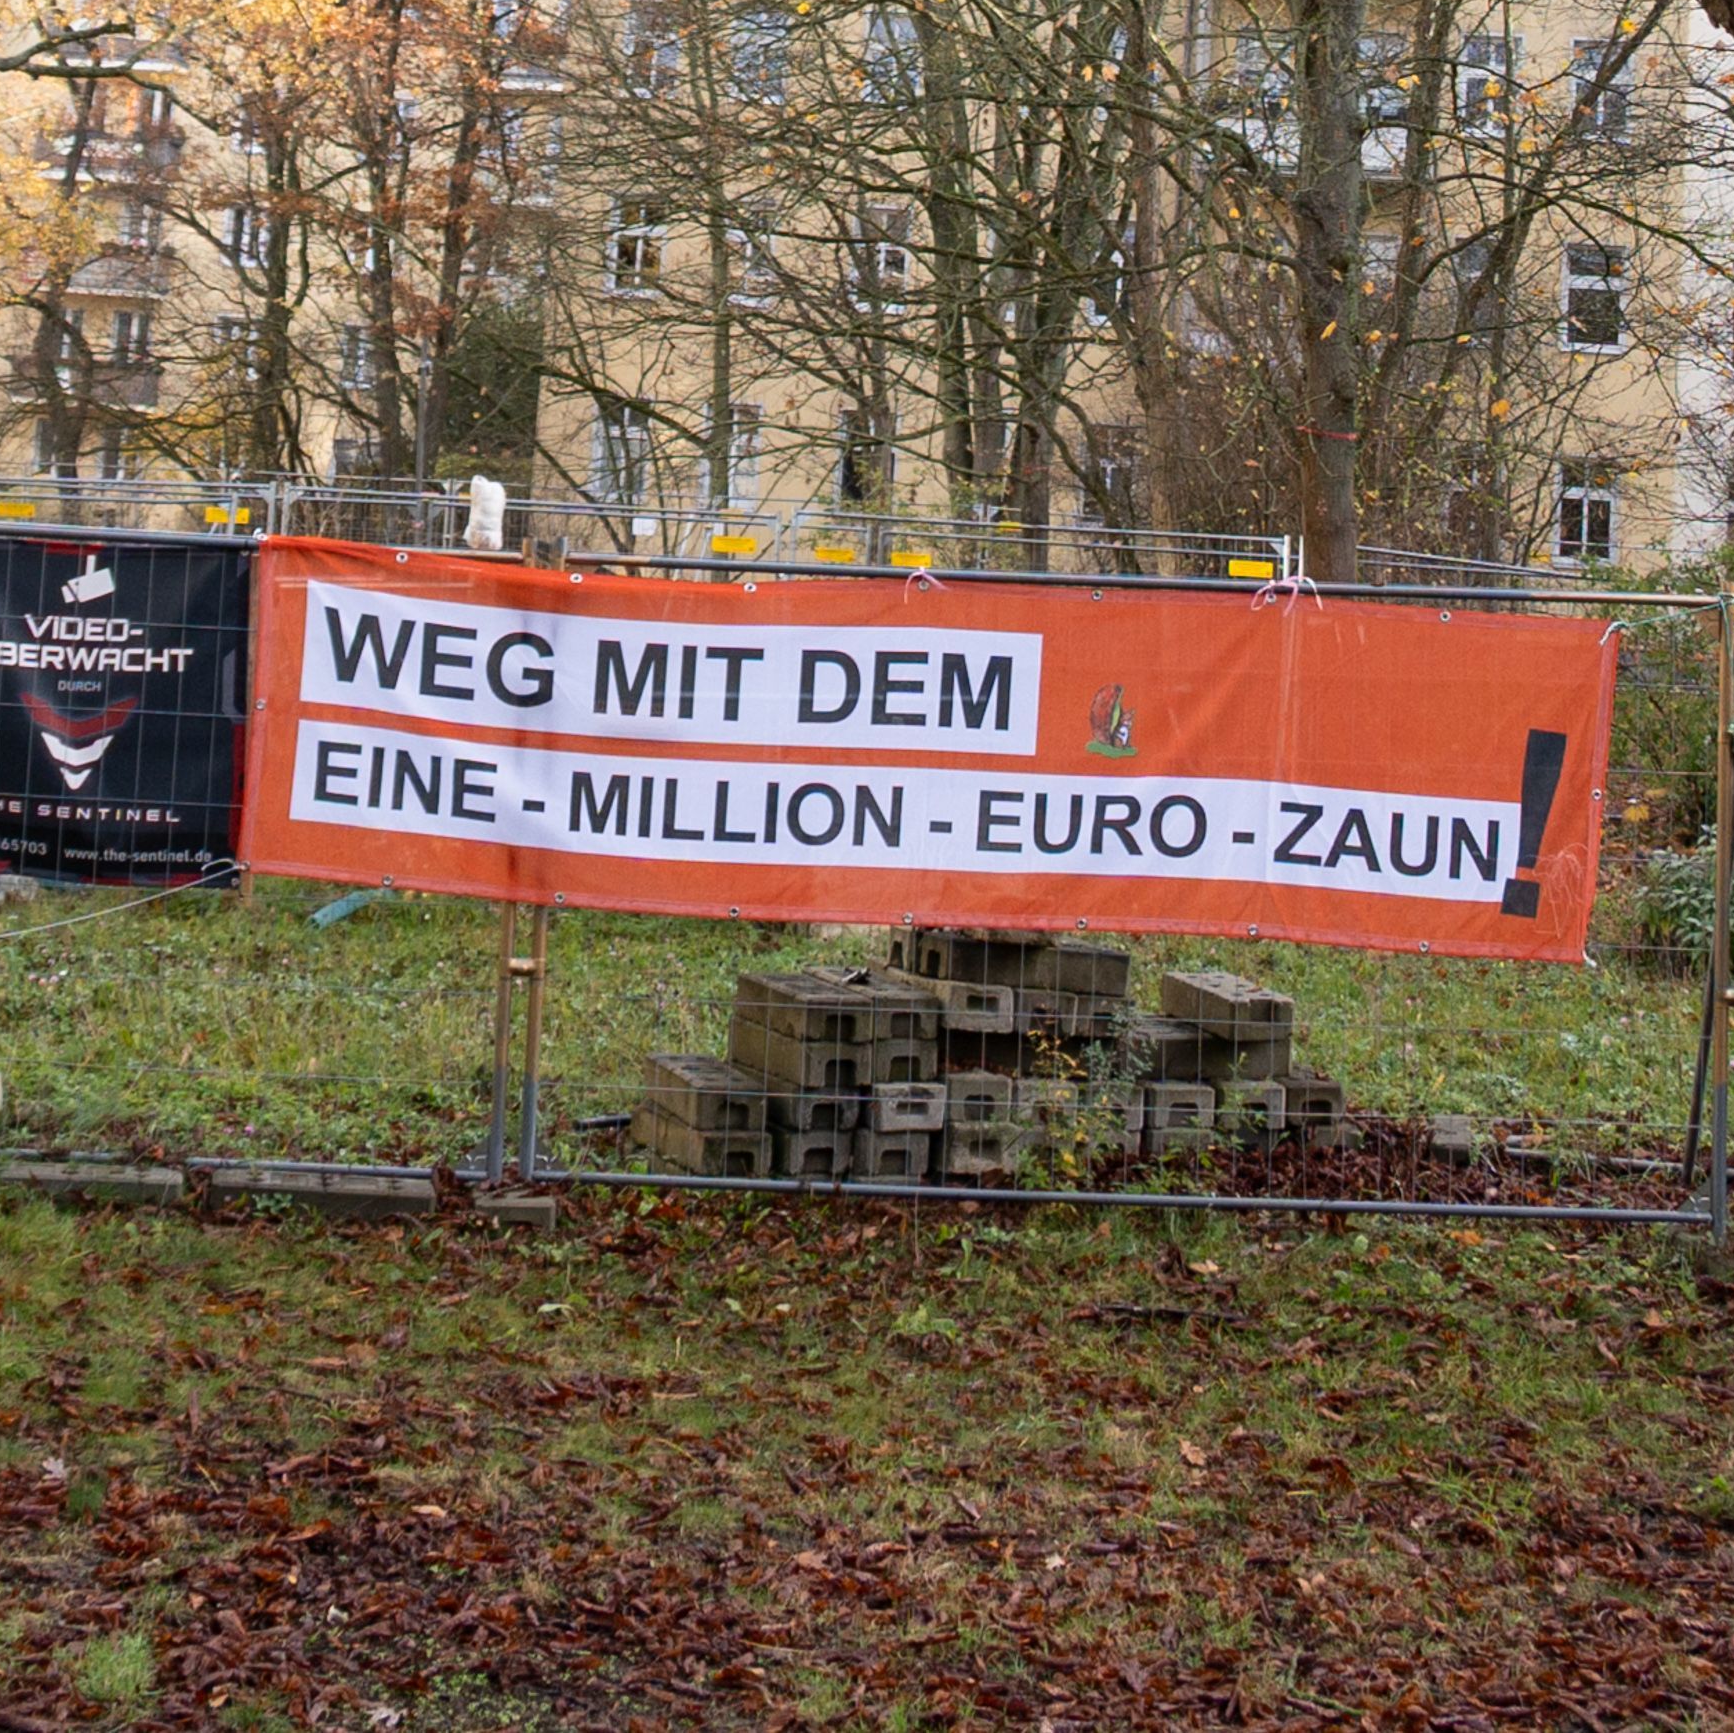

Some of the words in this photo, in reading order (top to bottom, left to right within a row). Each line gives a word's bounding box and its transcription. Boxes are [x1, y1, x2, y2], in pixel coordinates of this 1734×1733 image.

[24, 613, 144, 643] VIDEO-
[323, 606, 556, 708] WEG
[593, 639, 765, 722] MIT
[796, 649, 1013, 731] DEM
[57, 680, 102, 693] DURCH
[37, 803, 181, 823] SENTINEL
[63, 847, 213, 863] www.the-sentinel.de
